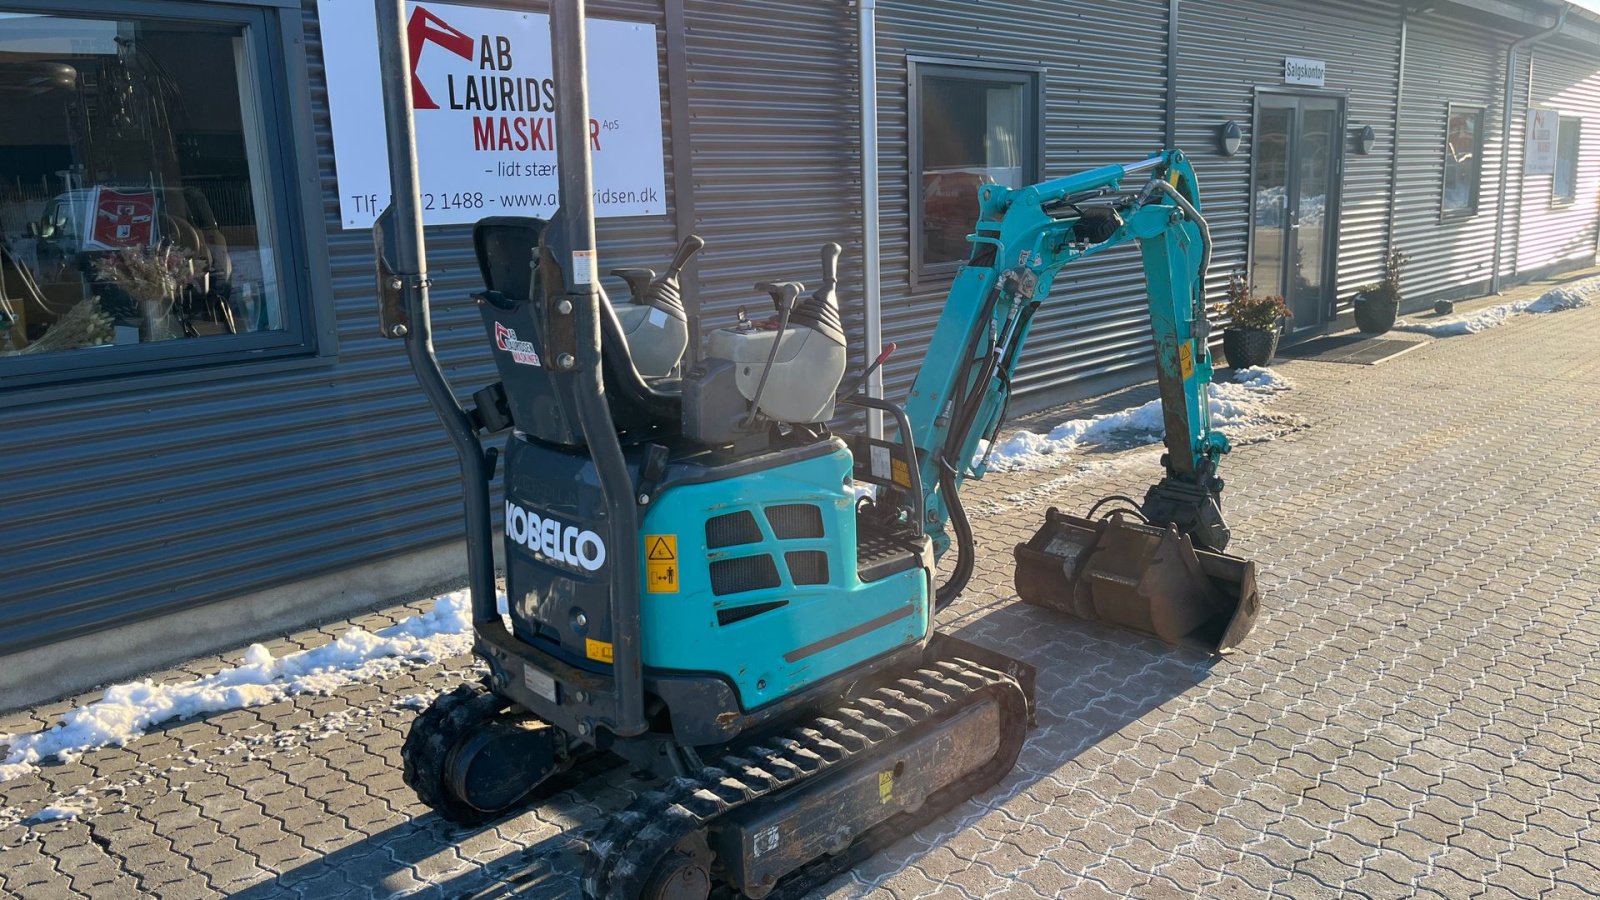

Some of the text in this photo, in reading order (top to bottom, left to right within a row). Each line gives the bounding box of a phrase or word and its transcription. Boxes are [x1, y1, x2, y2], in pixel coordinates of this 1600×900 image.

[480, 34, 512, 71] AB
[1286, 61, 1325, 81] Salgskontor
[447, 74, 556, 113] LAURIDS
[472, 116, 620, 151] MASKIR ApS
[498, 161, 521, 177] lidt
[525, 163, 557, 177] stær
[351, 194, 383, 217] Tlf.
[441, 192, 484, 210] 1488
[500, 187, 658, 208] www.aridsen.dk
[505, 499, 606, 571] KOBELCO
